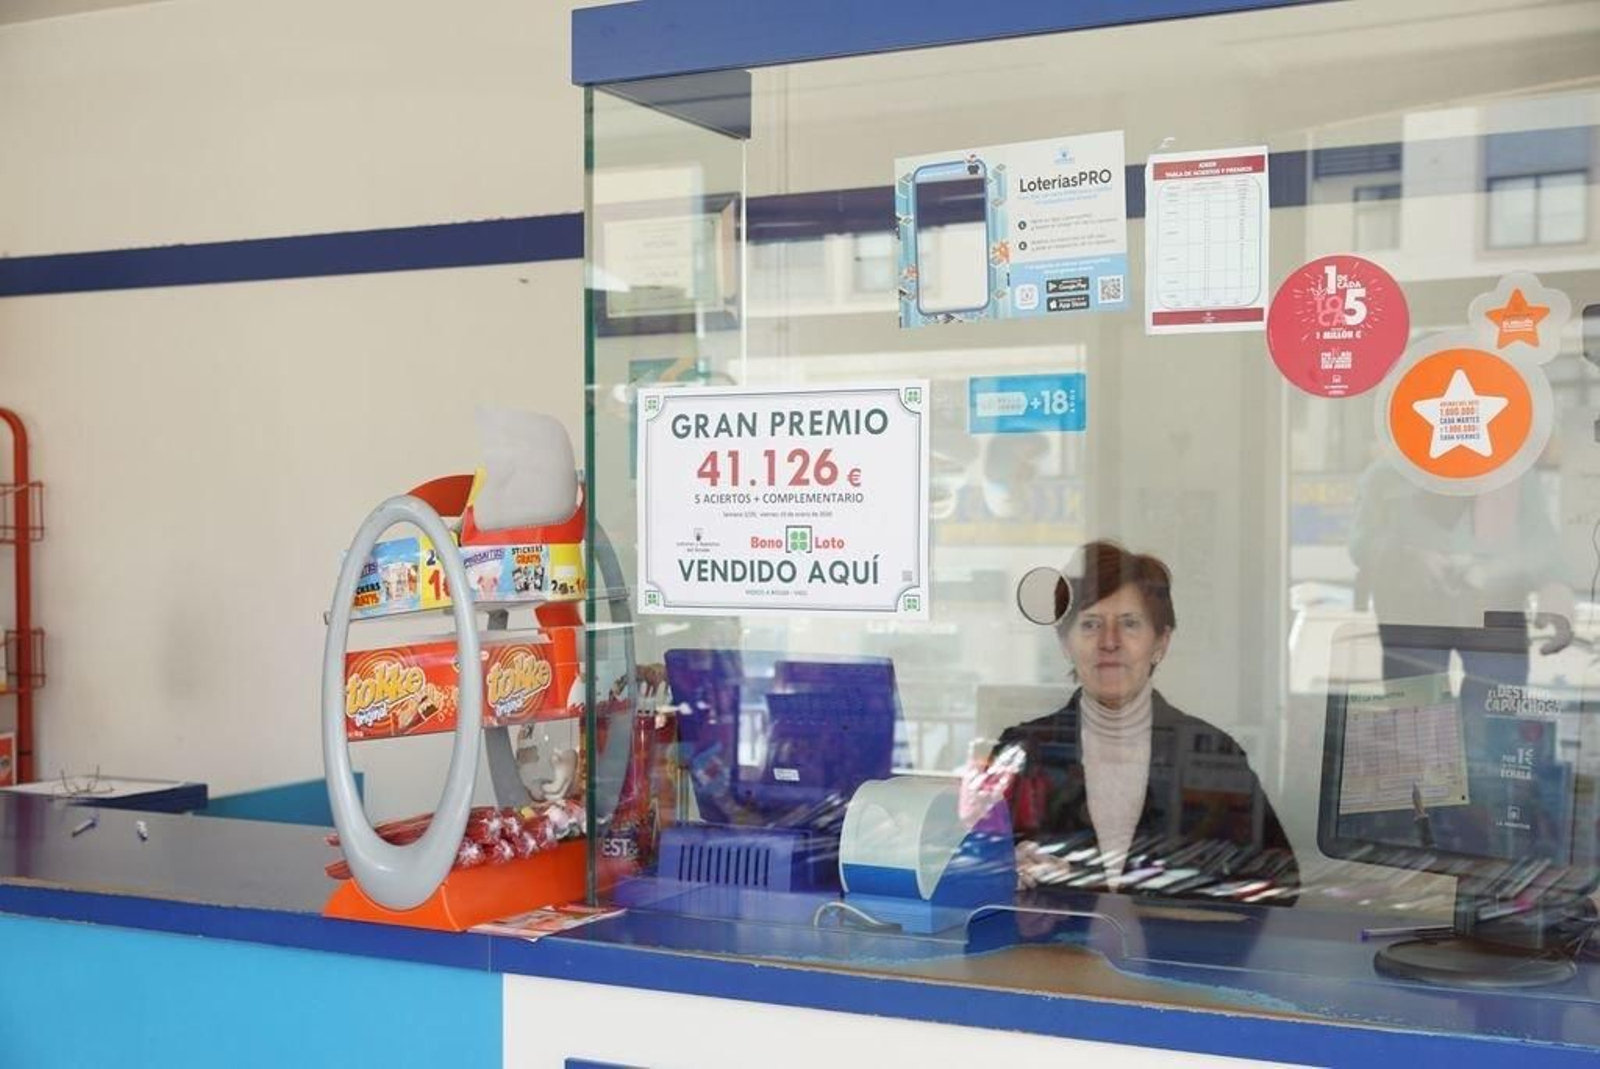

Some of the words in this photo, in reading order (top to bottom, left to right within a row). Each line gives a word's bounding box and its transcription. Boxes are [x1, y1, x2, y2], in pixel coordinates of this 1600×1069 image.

[1344, 288, 1367, 325] 5
[1030, 389, 1068, 415] +18
[671, 412, 757, 439] GRAN
[770, 408, 888, 436] PREMIO
[697, 448, 839, 487] 41.126
[847, 468, 861, 487] €
[694, 493, 701, 504] 5
[703, 493, 751, 504] ACIERTOS
[762, 492, 865, 504] COMPLEMENTARIO
[751, 536, 783, 549] Bono
[815, 536, 845, 549] Loto
[678, 559, 797, 583] VENDIDO
[808, 554, 879, 586] AQUÍ
